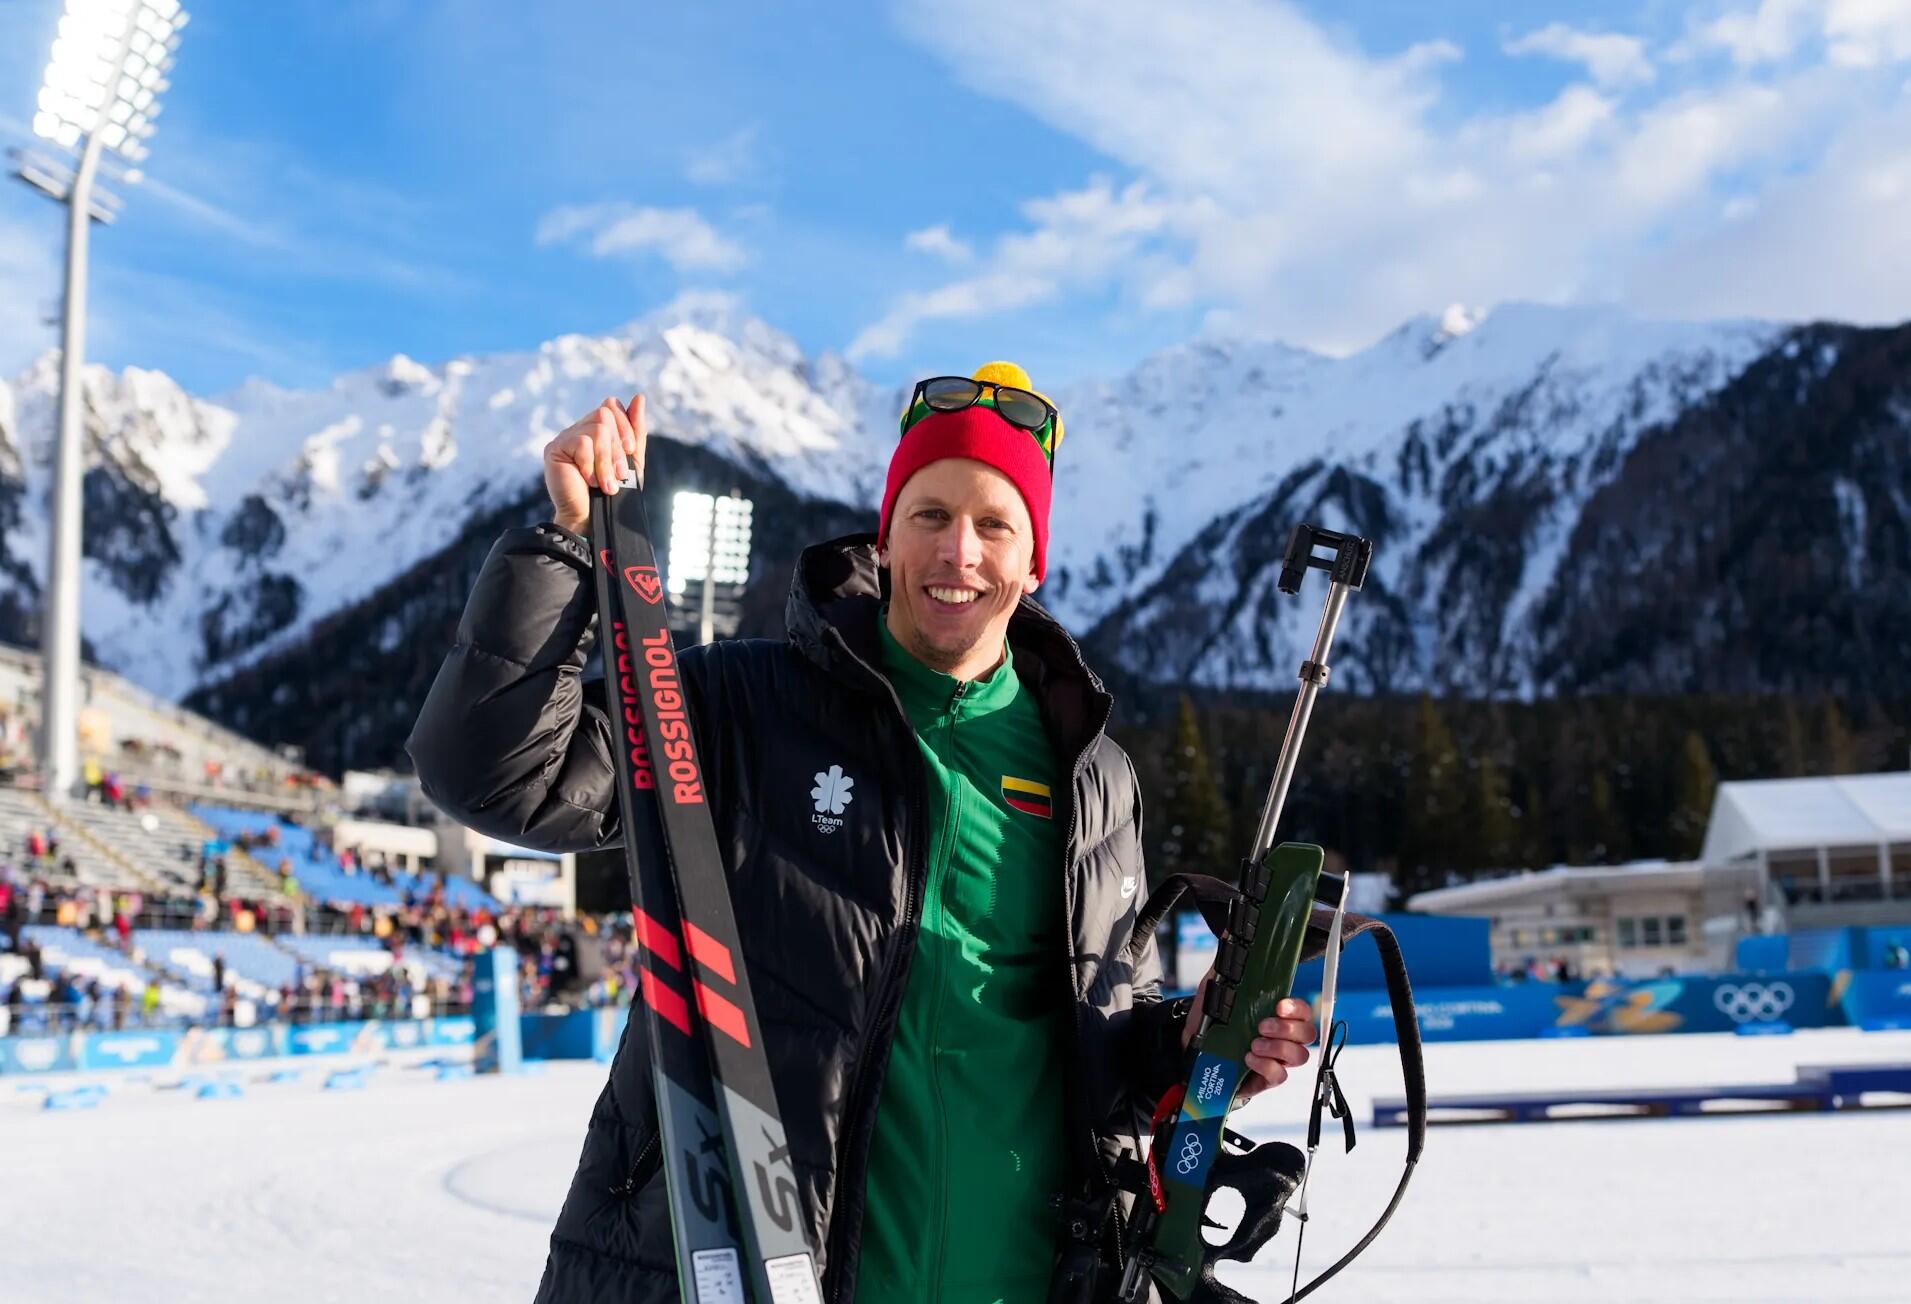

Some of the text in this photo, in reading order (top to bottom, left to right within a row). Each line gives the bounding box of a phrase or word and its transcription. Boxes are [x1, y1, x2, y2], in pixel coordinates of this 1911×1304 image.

[642, 628, 704, 805] ROSSIGNOL
[811, 813, 843, 826] LTeam
[1196, 1067, 1211, 1104] MILANO
[1204, 1063, 1222, 1100] CORTINA
[1213, 1077, 1225, 1096] 2026
